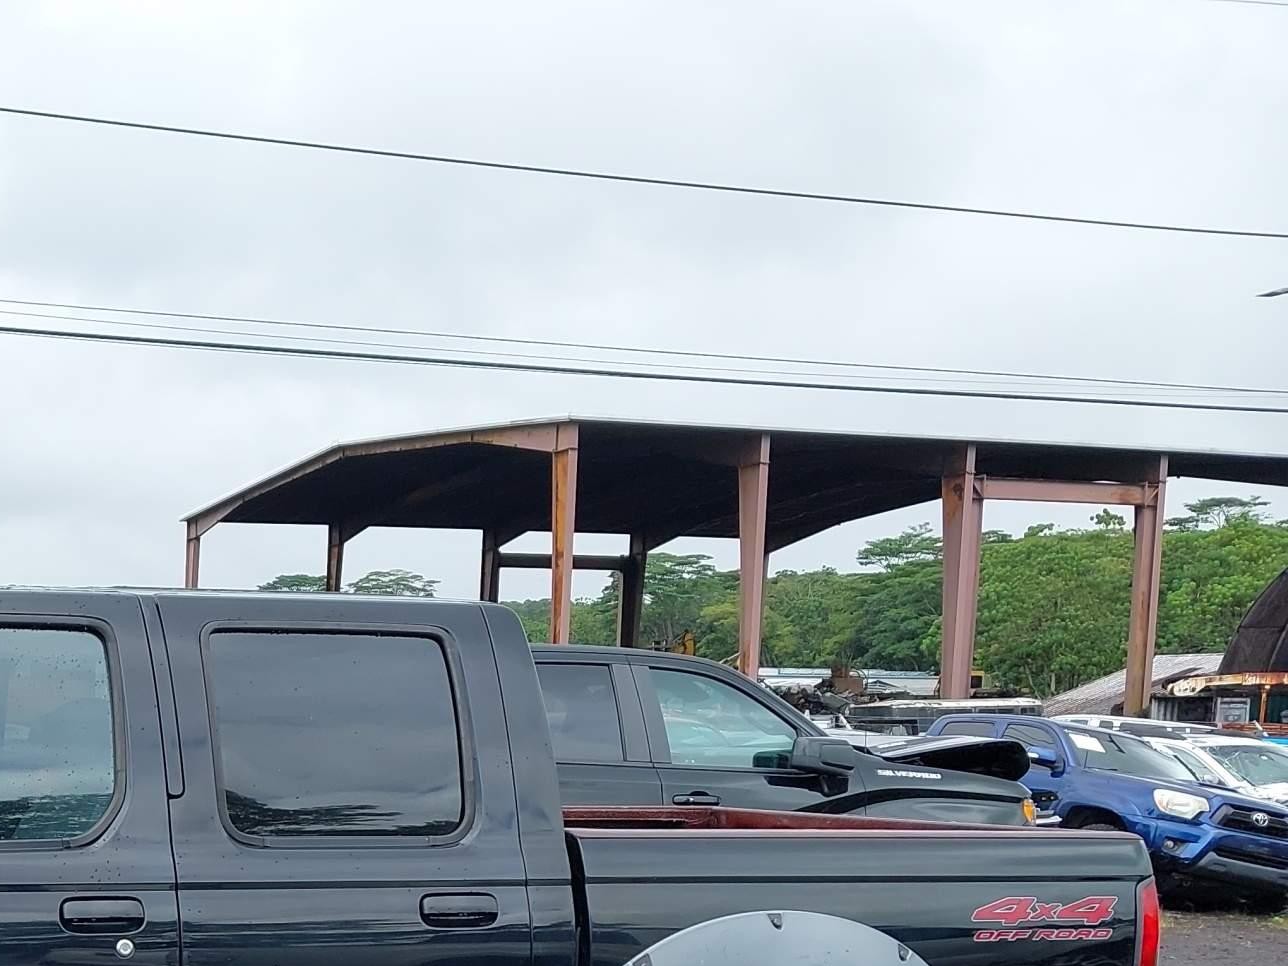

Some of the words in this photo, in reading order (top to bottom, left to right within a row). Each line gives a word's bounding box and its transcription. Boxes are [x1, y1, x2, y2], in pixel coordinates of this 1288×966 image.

[971, 896, 1119, 926] 4x4
[974, 930, 1033, 942] OFF
[1032, 928, 1113, 941] ROAD
